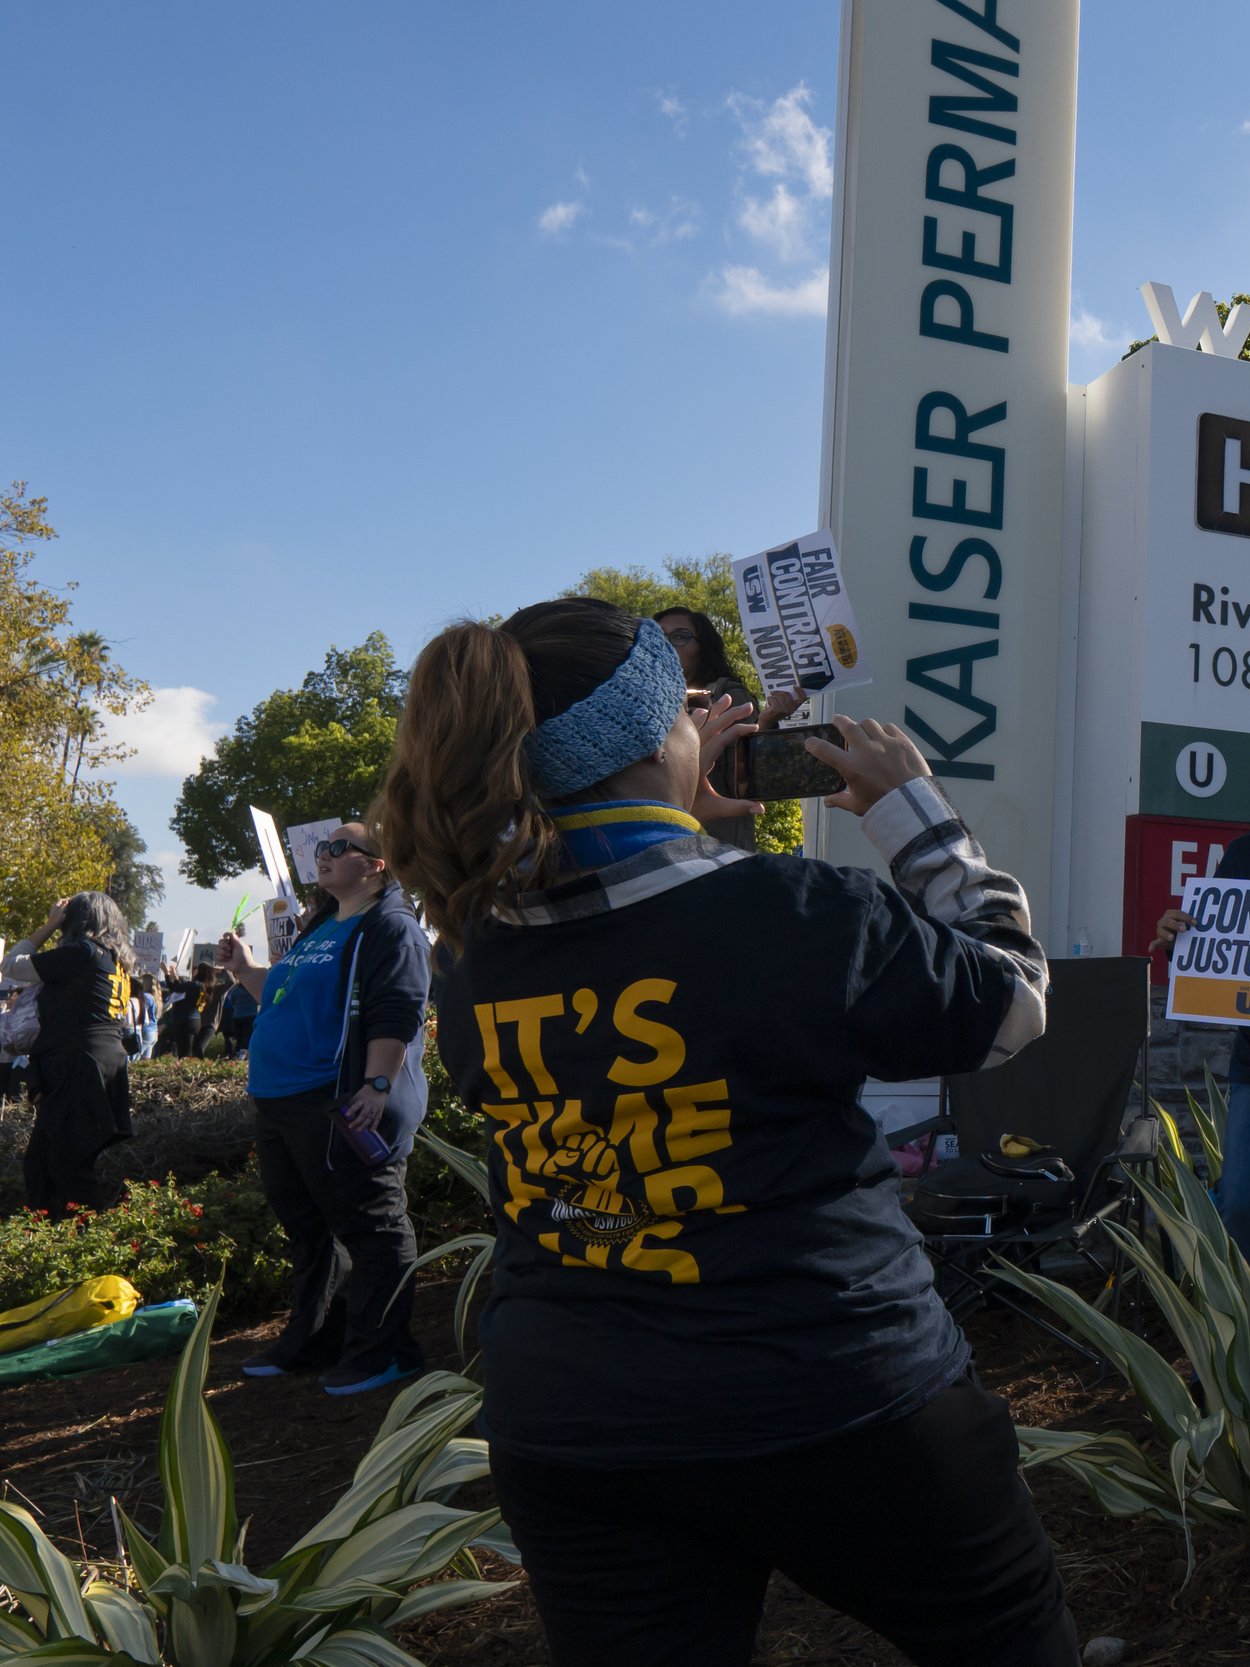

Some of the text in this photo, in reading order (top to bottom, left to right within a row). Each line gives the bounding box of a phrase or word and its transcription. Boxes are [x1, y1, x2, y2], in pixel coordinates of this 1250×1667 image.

[743, 564, 767, 613] USW
[801, 547, 841, 599] FAIR
[904, 390, 1007, 781] KAISER
[770, 557, 832, 677] CONTRACT
[749, 624, 797, 690] NOW!
[1189, 751, 1214, 788] U
[474, 977, 687, 1098] IT'S
